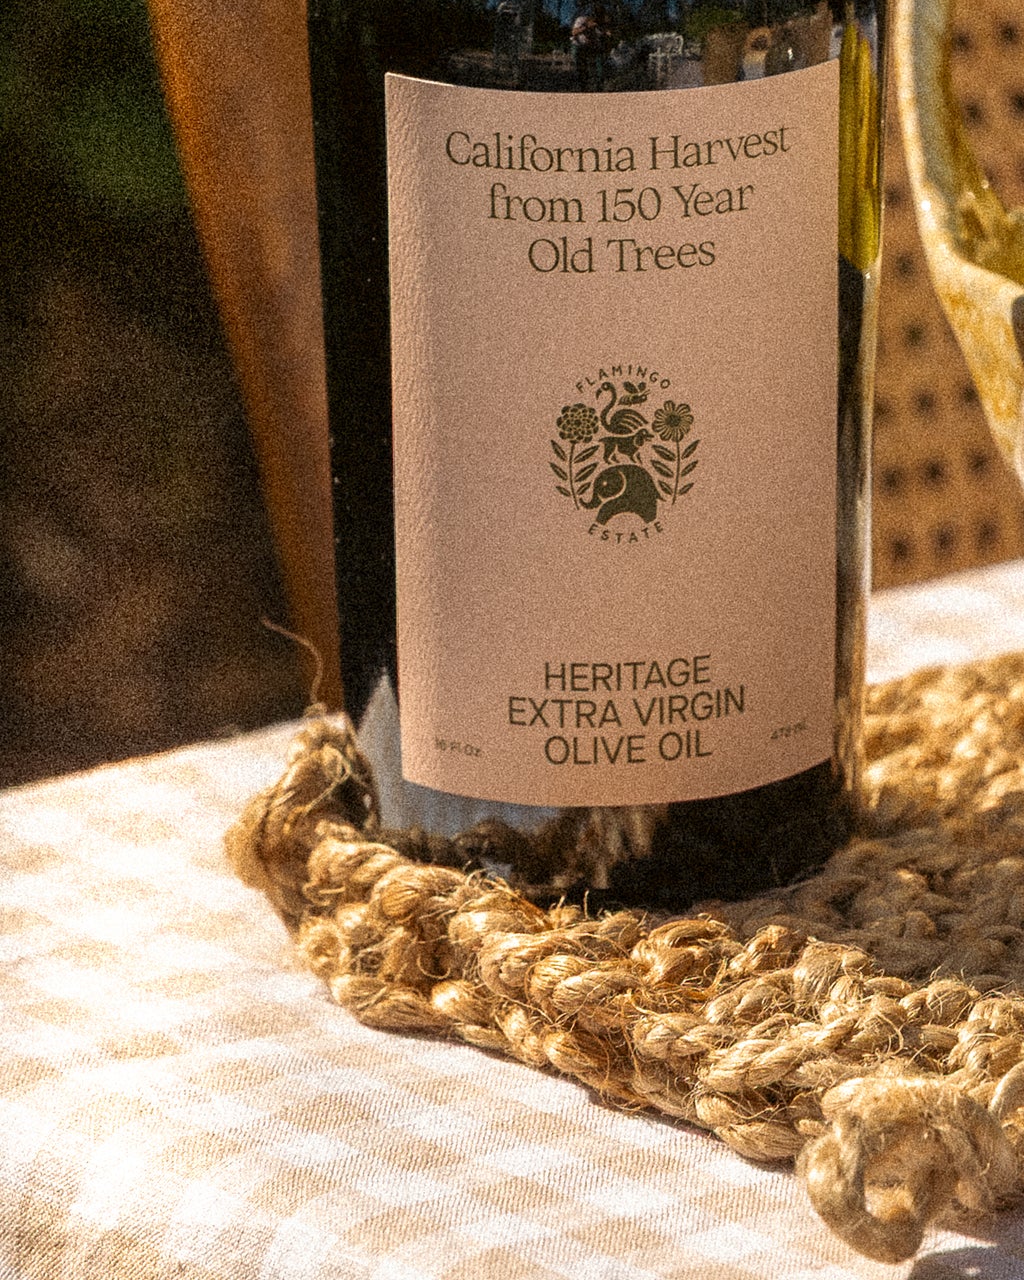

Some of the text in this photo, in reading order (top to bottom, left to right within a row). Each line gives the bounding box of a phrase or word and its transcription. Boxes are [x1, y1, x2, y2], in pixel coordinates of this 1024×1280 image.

[445, 127, 793, 173] California Harvest
[488, 183, 755, 223] from 150 Year
[528, 237, 716, 273] Old Trees
[576, 365, 671, 393] FLAMINGO
[588, 521, 664, 544] ESTATE
[544, 654, 712, 692] HERITAGE
[508, 685, 746, 729] EXTRA VIRGIN
[544, 730, 713, 766] OLIVE OIL
